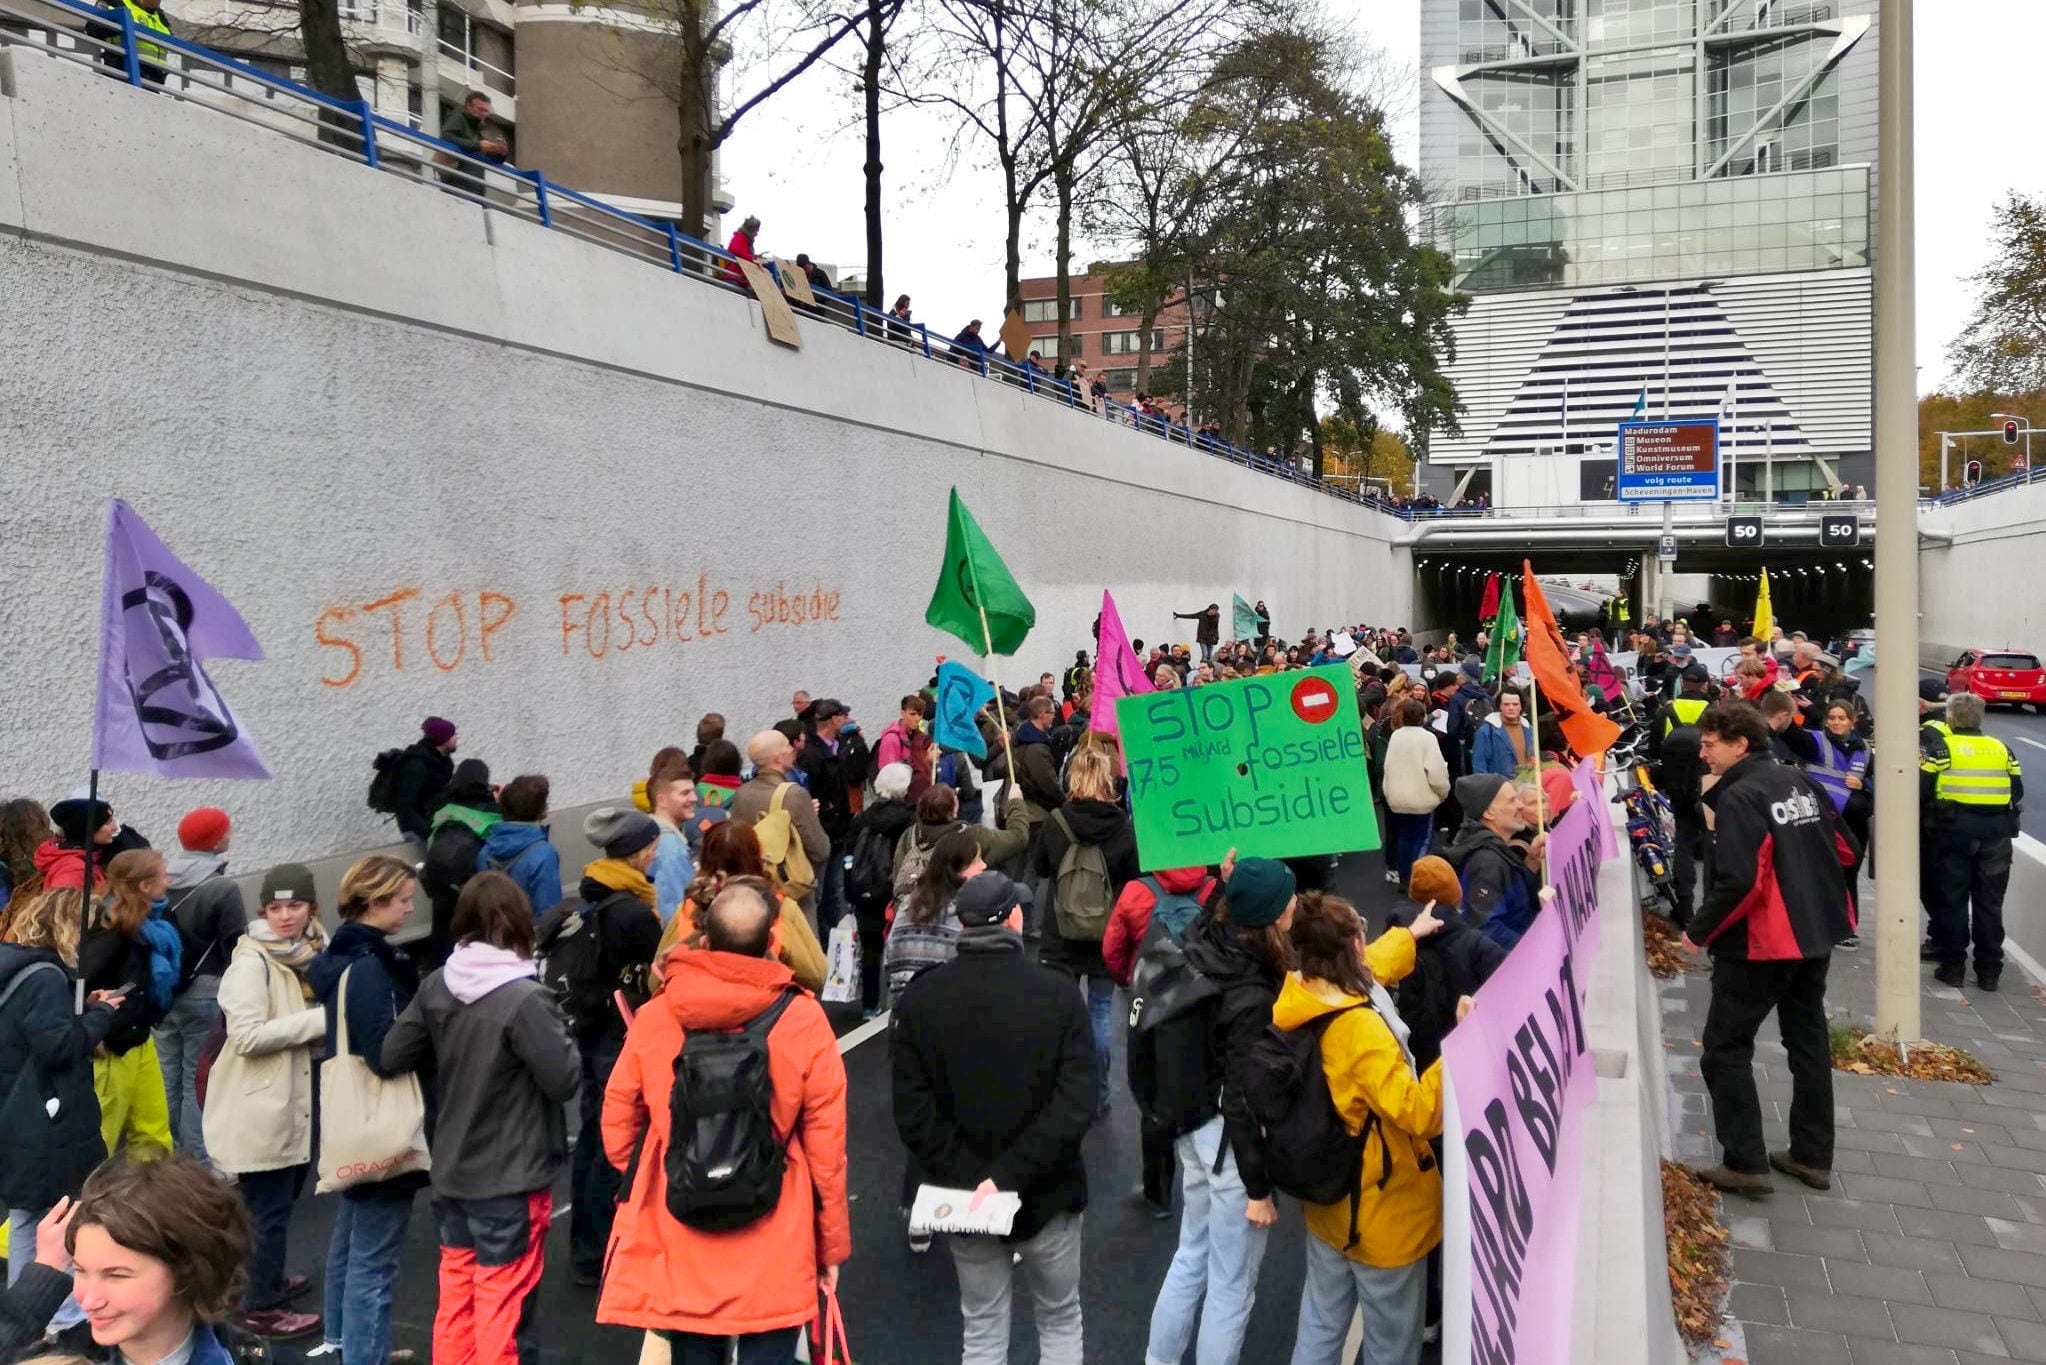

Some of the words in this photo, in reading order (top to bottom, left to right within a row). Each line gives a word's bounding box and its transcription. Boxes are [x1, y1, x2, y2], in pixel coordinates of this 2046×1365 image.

[1624, 427, 1678, 435] Madurodam
[1636, 445, 1701, 453] Kunstmuseum
[1636, 454, 1693, 462] Omniversum
[1644, 476, 1664, 485] volg
[1624, 487, 1713, 496] Scheveningen-Haven
[1734, 525, 1757, 538] 50
[1829, 524, 1853, 537] 50
[315, 586, 516, 688] STOP
[1147, 683, 1273, 747] STOP
